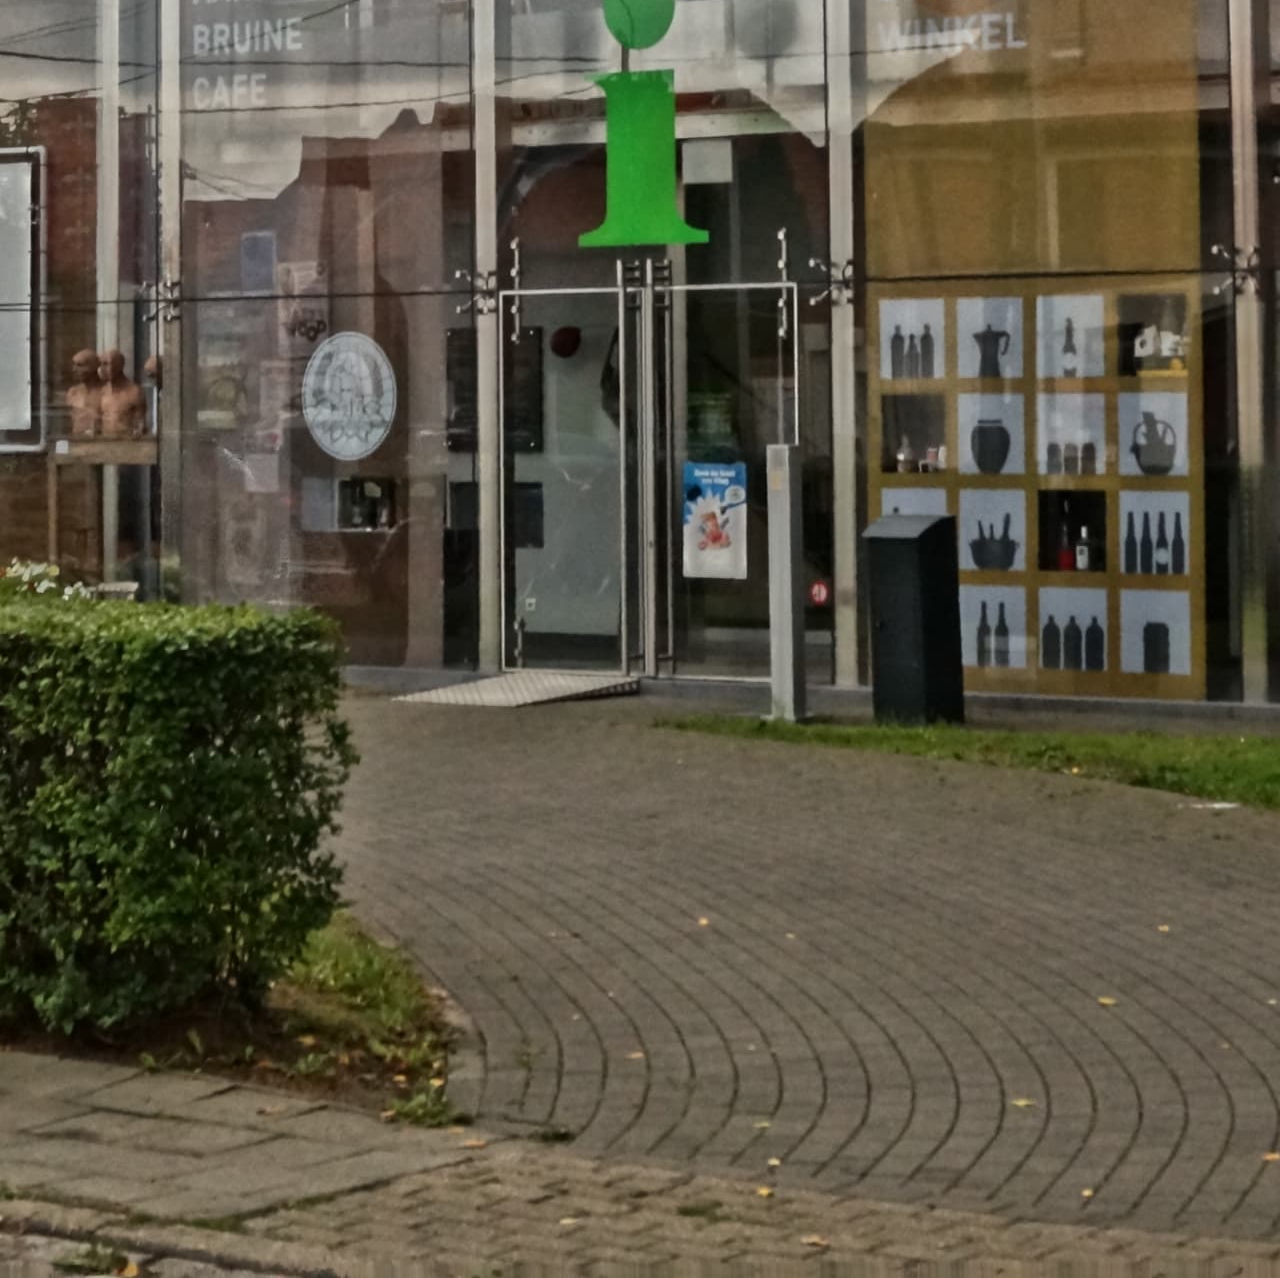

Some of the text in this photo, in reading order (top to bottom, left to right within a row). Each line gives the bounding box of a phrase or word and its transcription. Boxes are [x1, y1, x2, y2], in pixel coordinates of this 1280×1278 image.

[193, 17, 303, 57] BRUINE
[877, 12, 1027, 55] WINKEL
[192, 74, 267, 109] CAFE
